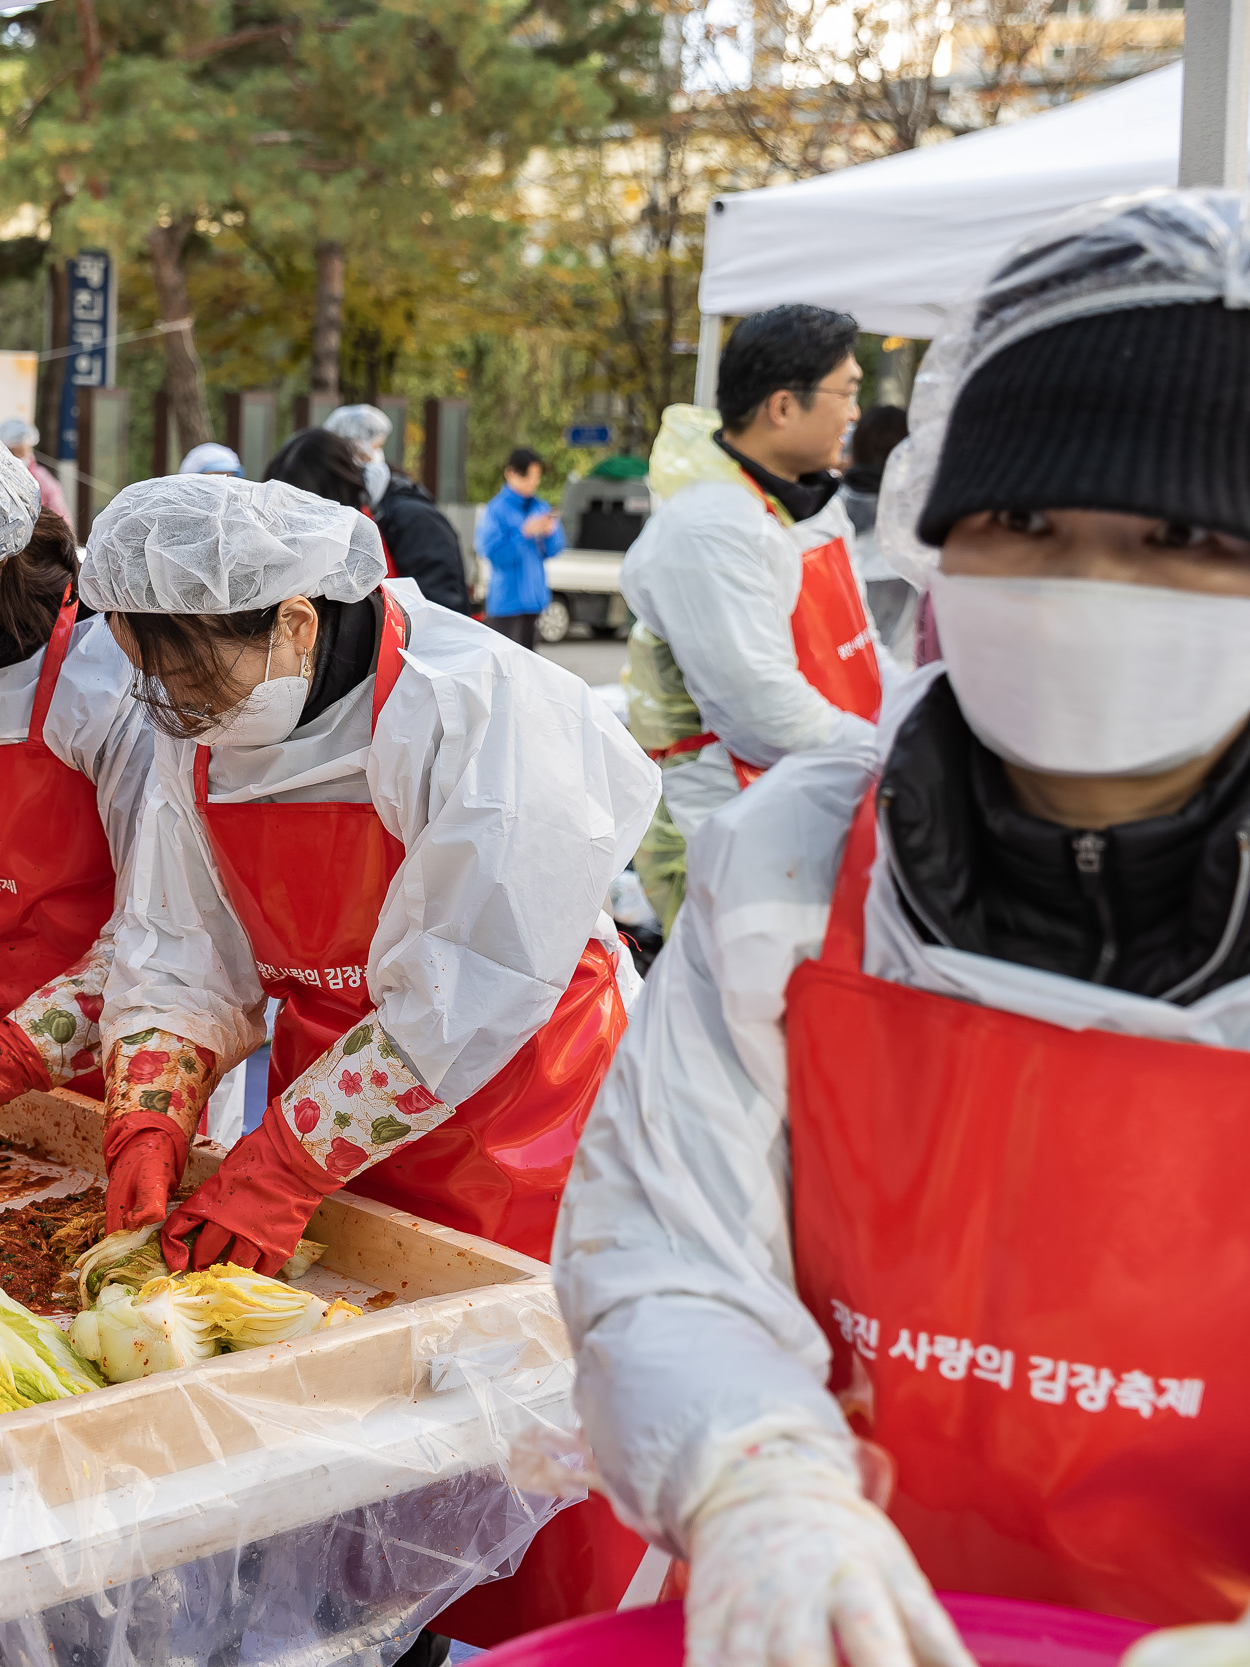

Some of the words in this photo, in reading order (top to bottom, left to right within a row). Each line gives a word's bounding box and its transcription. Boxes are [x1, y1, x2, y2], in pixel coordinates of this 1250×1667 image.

[324, 965, 368, 990] 김장
[830, 1298, 880, 1360] 광진
[888, 1328, 1015, 1390] 사랑의
[1027, 1354, 1206, 1419] 김장축제
